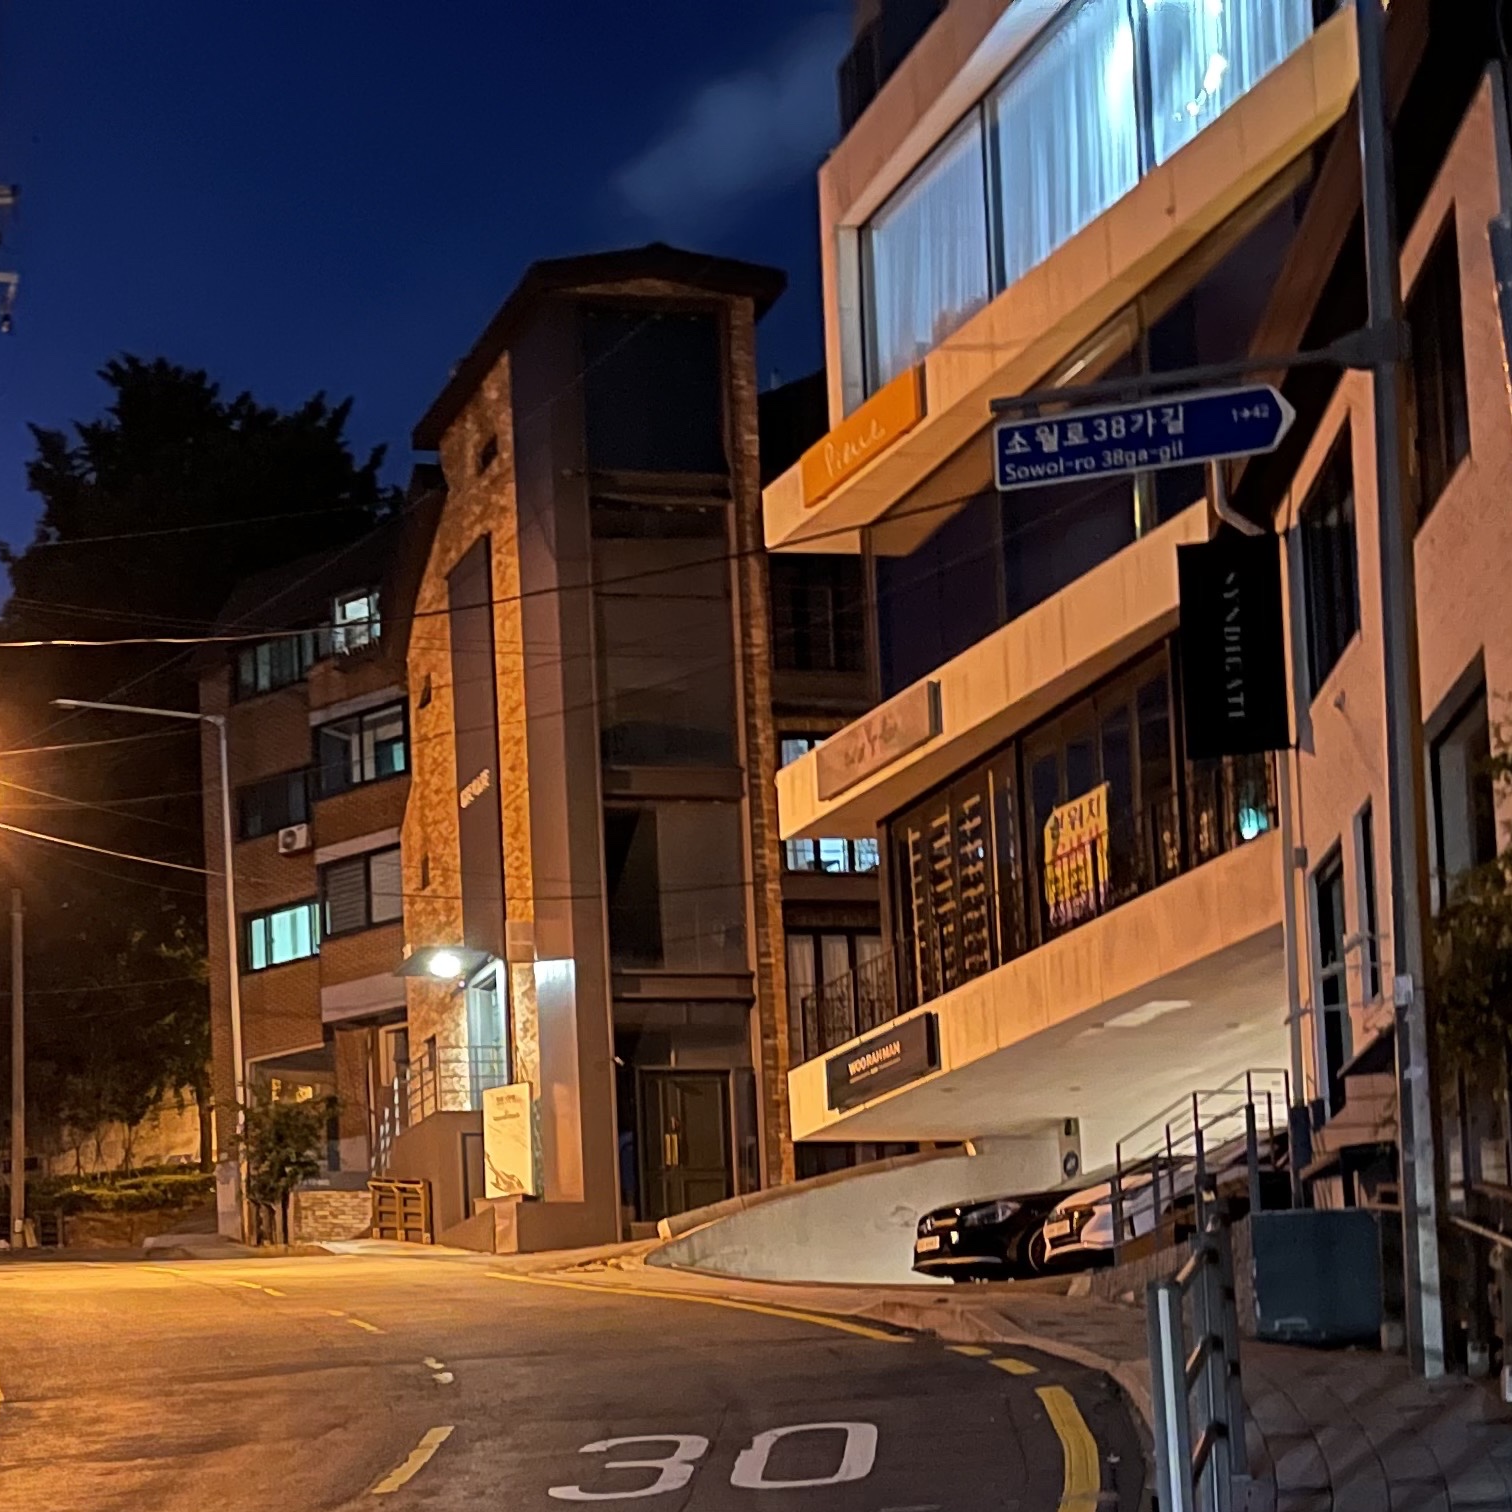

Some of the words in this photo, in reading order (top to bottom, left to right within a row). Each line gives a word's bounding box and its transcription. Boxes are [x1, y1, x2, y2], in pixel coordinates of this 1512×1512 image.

[1004, 456, 1096, 482] Sowol-ro
[1101, 441, 1184, 468] 38ga-gil
[547, 1421, 879, 1501] 30
